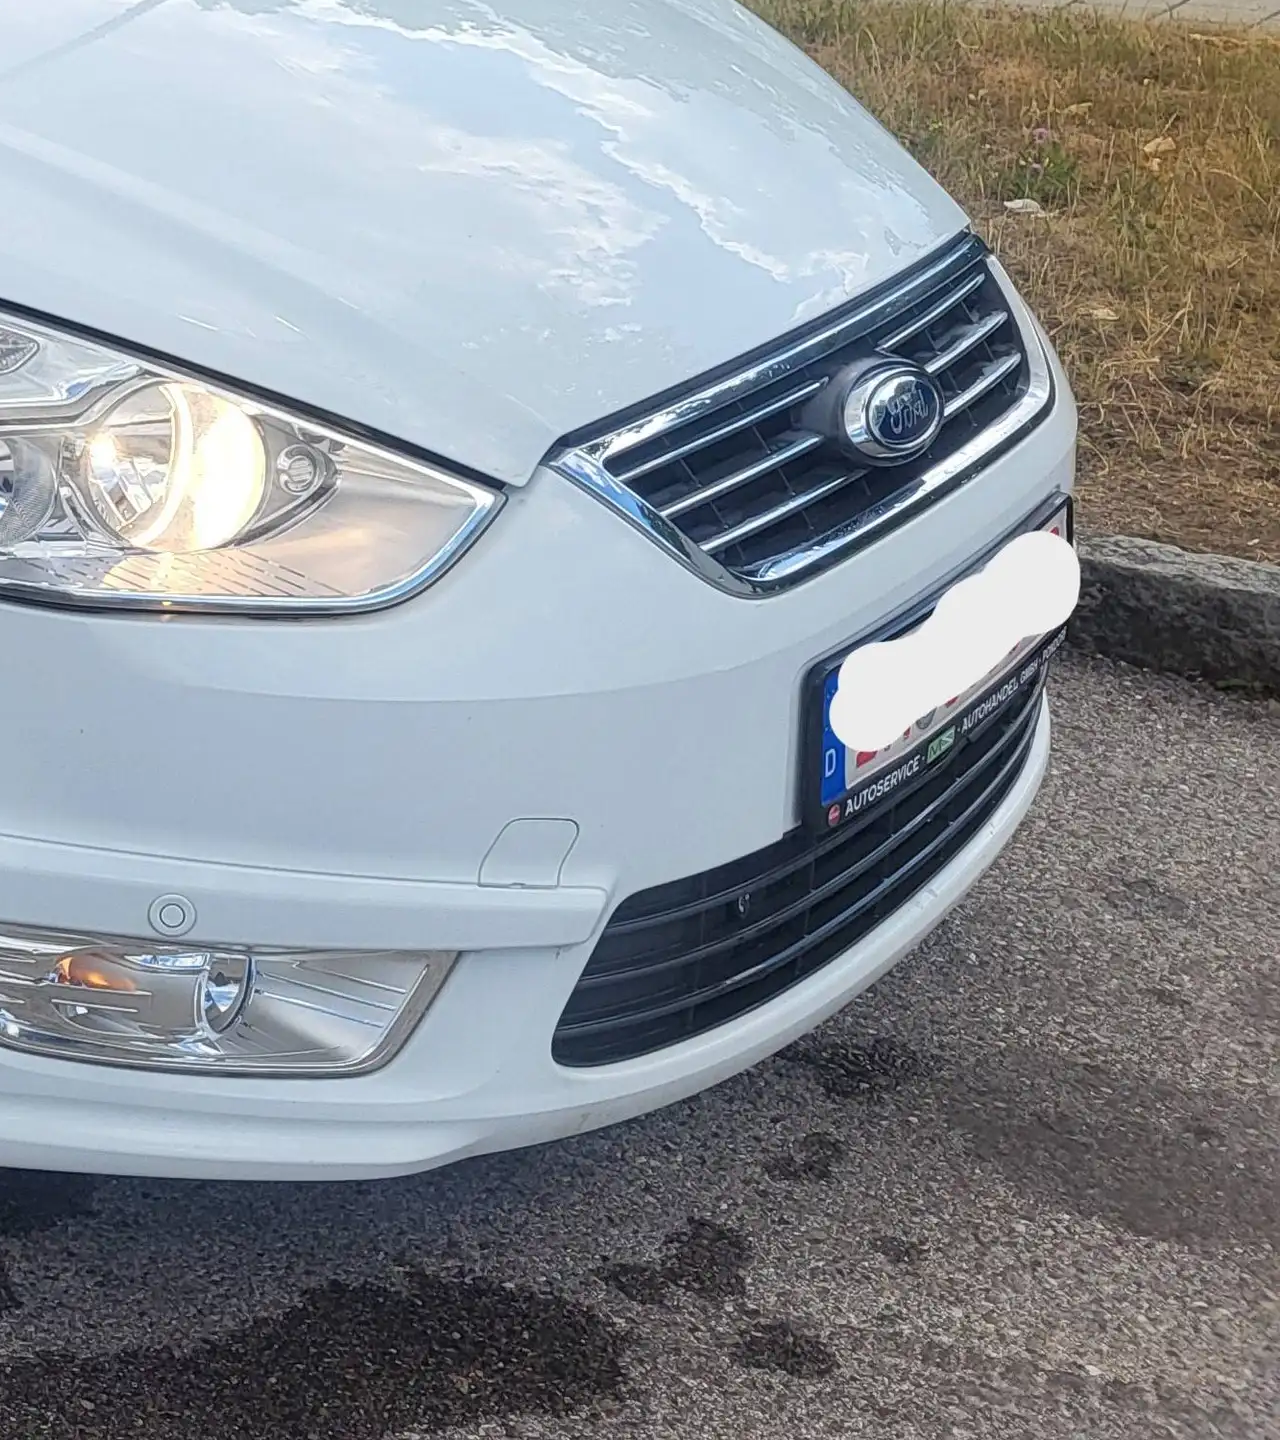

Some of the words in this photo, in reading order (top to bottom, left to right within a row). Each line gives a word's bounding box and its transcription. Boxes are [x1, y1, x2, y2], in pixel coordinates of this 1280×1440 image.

[886, 388, 928, 434] Ford
[824, 748, 836, 778] D
[844, 754, 921, 817] AUTOSERVICE
[961, 676, 1019, 734] AUTOHANDEL
